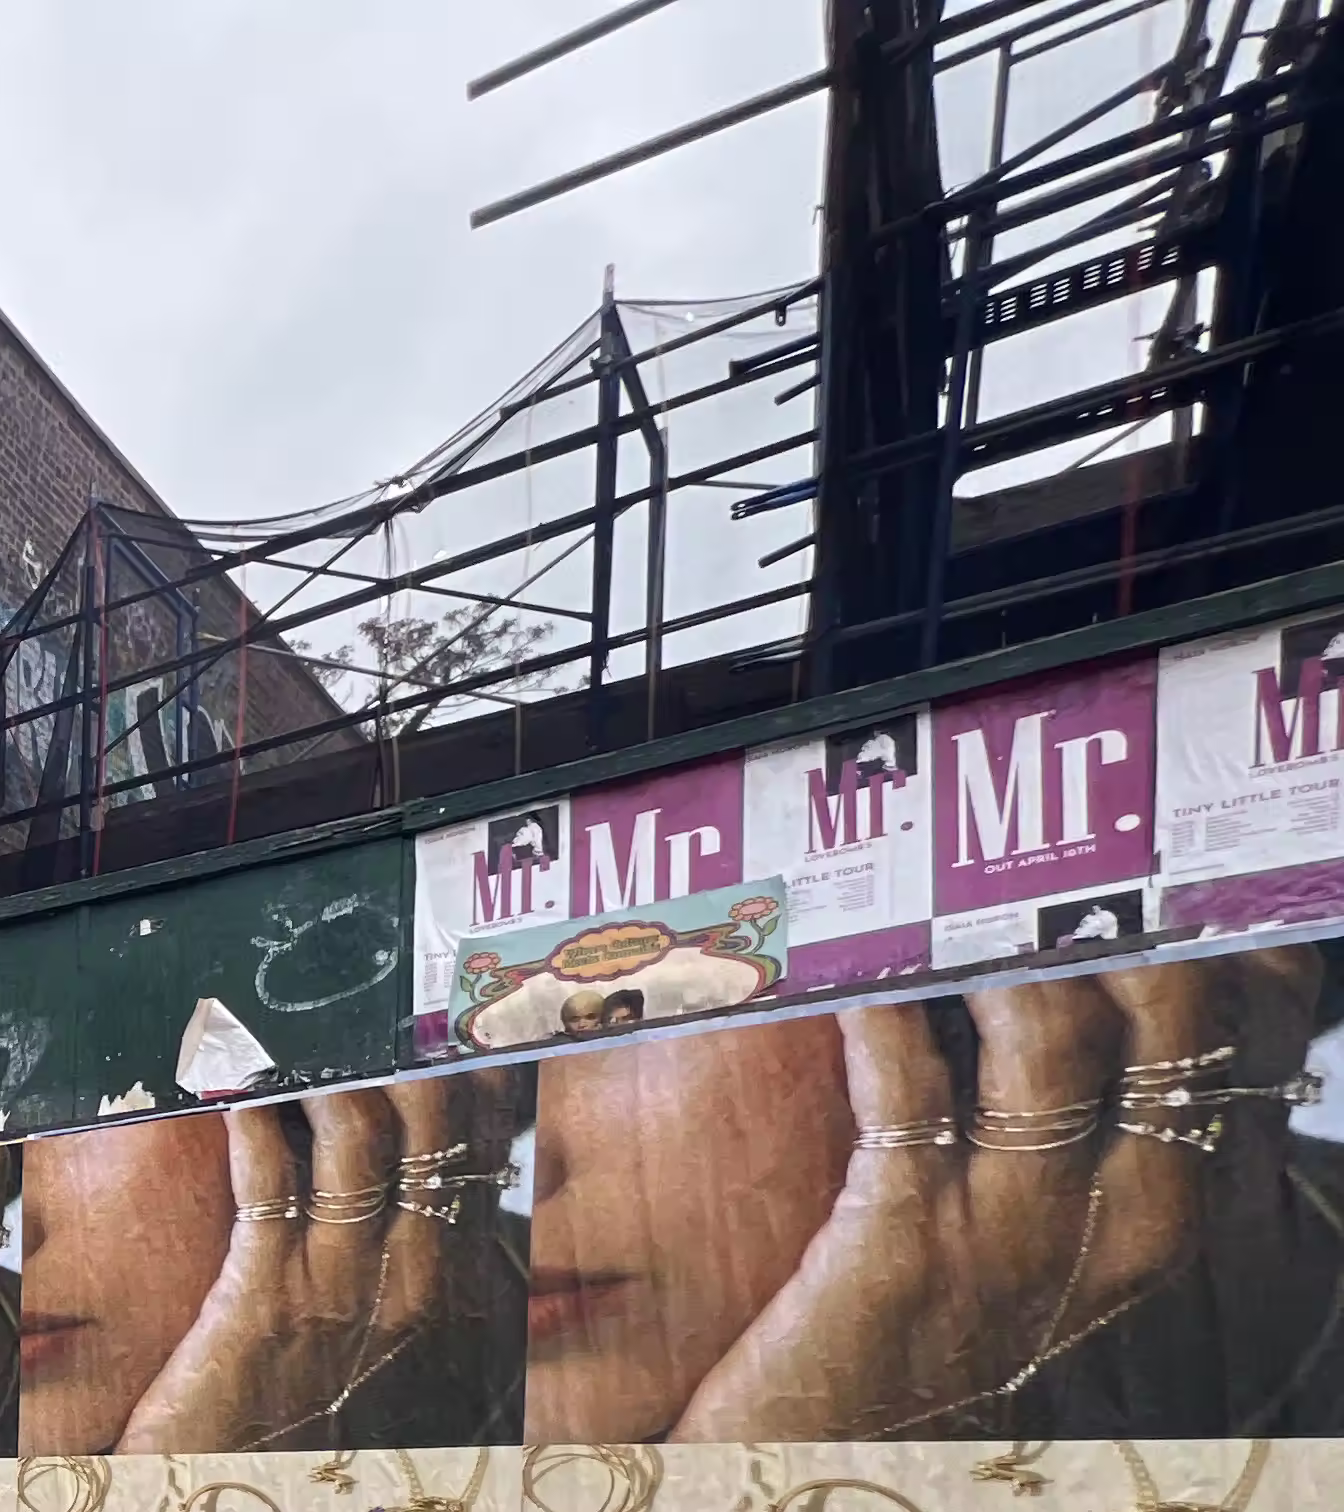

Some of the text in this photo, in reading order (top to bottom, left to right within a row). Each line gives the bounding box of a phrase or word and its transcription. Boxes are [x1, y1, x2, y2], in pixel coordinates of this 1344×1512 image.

[804, 757, 913, 854] Mr.
[951, 710, 1140, 868] Mr.
[1173, 778, 1341, 818] TINY LITTLE TOUR
[469, 842, 555, 927] Mr.
[834, 862, 874, 878] TOUR
[984, 861, 1013, 875] OUT
[1018, 853, 1059, 868] APRIL
